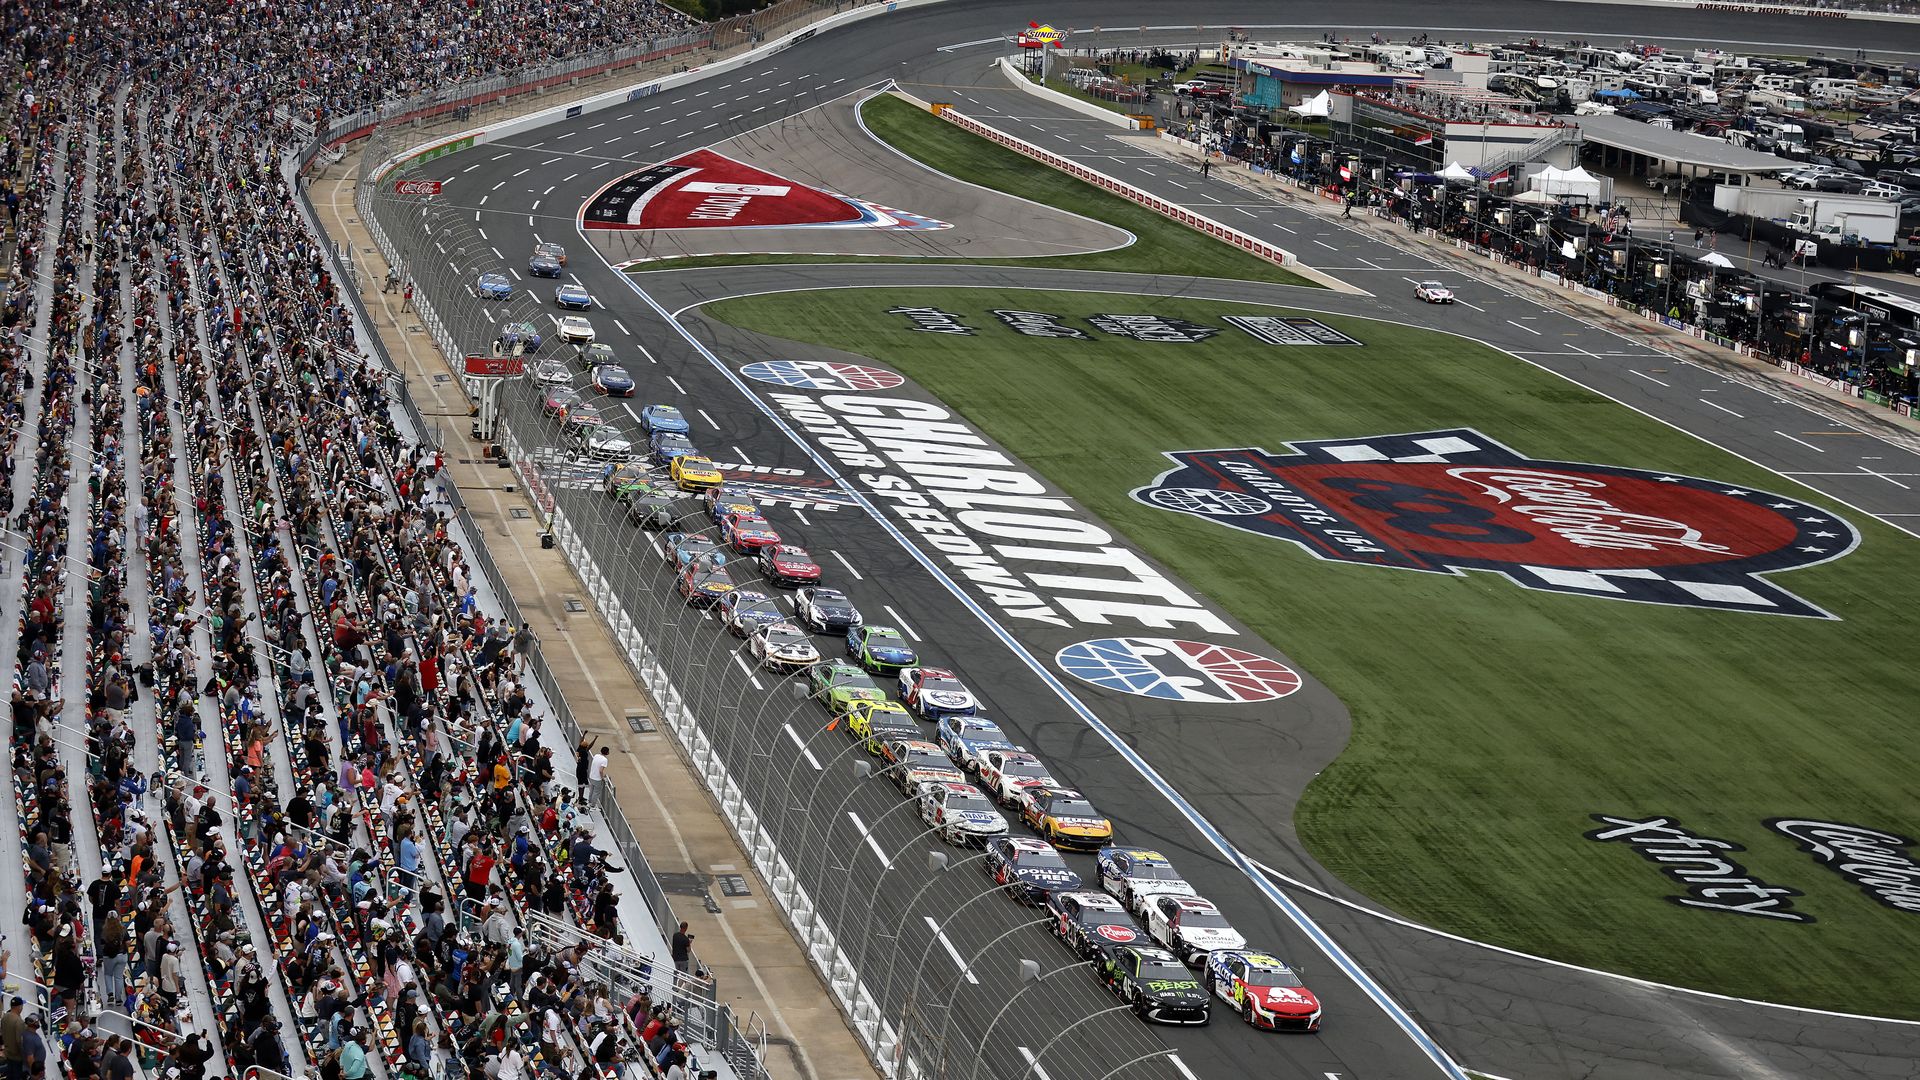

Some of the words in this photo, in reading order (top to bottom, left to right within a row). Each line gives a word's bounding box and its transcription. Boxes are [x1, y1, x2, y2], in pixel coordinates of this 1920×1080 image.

[1807, 10, 1848, 19] RACING
[1029, 31, 1064, 39] SUNOCO
[686, 195, 752, 220] TOYOTA
[767, 392, 886, 468] MOTOR
[858, 473, 1073, 628] SPEEDWAY
[820, 394, 1240, 635] CHARLOTTE
[1446, 467, 1746, 557] Coca-Cola
[1323, 529, 1386, 553] USA
[1018, 868, 1078, 878] DOLLAR
[1146, 980, 1199, 992] BEAST
[1266, 997, 1313, 1005] AXALTA
